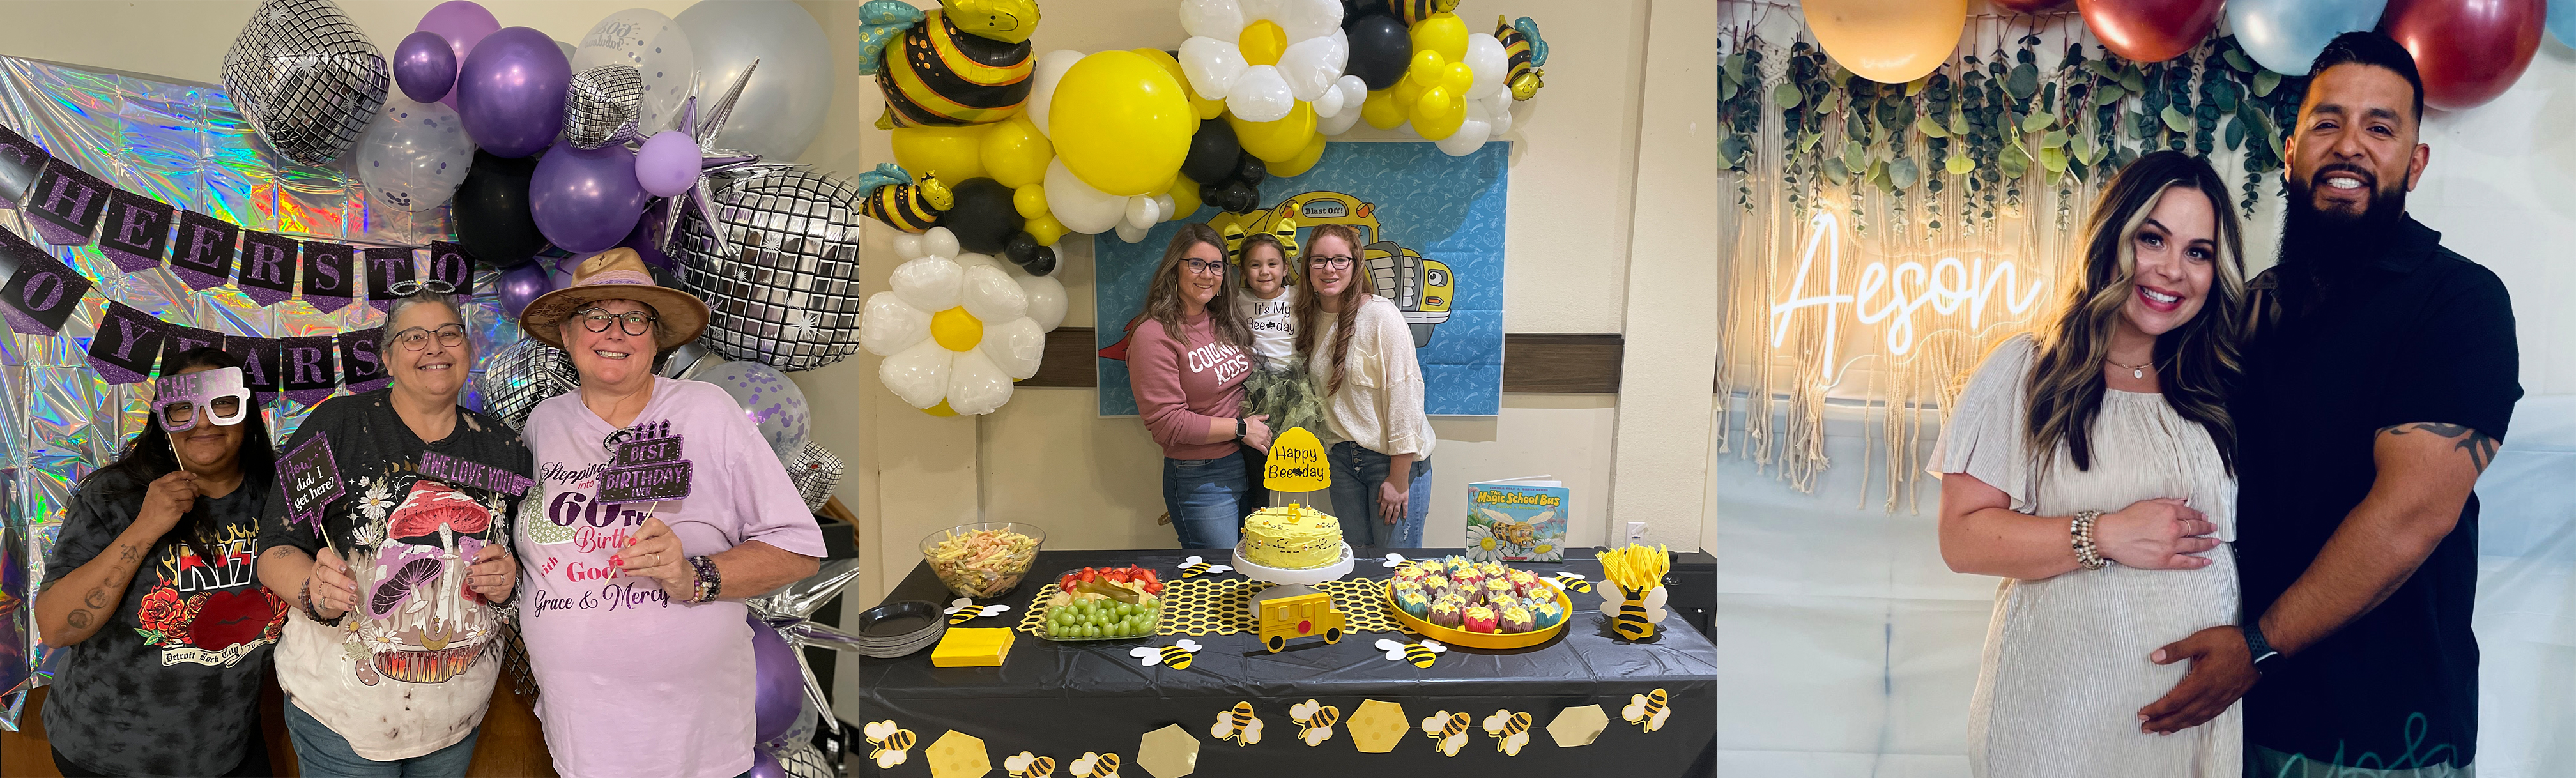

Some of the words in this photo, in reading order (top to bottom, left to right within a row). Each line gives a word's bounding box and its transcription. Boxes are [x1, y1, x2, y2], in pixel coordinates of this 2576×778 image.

[1770, 212, 2042, 379] Aeson
[1254, 302, 1270, 316] It's
[1273, 301, 1291, 318] My
[1188, 340, 1240, 374] COLONI
[1213, 353, 1249, 386] KIDS
[157, 366, 241, 399] CHEERS
[629, 441, 669, 462] BEST
[1275, 446, 1317, 464] Happy
[284, 457, 314, 484] How
[296, 471, 315, 492] did
[316, 465, 323, 479] I
[420, 451, 452, 478] #WE
[450, 458, 486, 487] LOVE
[487, 466, 513, 494] YOU
[539, 461, 607, 486] Stepping
[606, 466, 685, 491] BIRTHDAY
[295, 492, 310, 512] get
[309, 477, 335, 500] here?
[577, 480, 594, 489] into
[631, 486, 652, 498] EVER
[1476, 491, 1505, 505] Magic
[1506, 492, 1539, 505] School
[1539, 494, 1561, 507] Bus
[1287, 503, 1301, 524] 5
[176, 538, 257, 592] KIS
[540, 556, 558, 578] ith
[534, 590, 574, 618] Grace
[579, 590, 599, 610] &
[602, 581, 670, 612] Mercy
[165, 651, 197, 663] Detroit
[199, 652, 220, 663] Rock
[221, 645, 239, 659] City
[244, 642, 256, 652] '76
